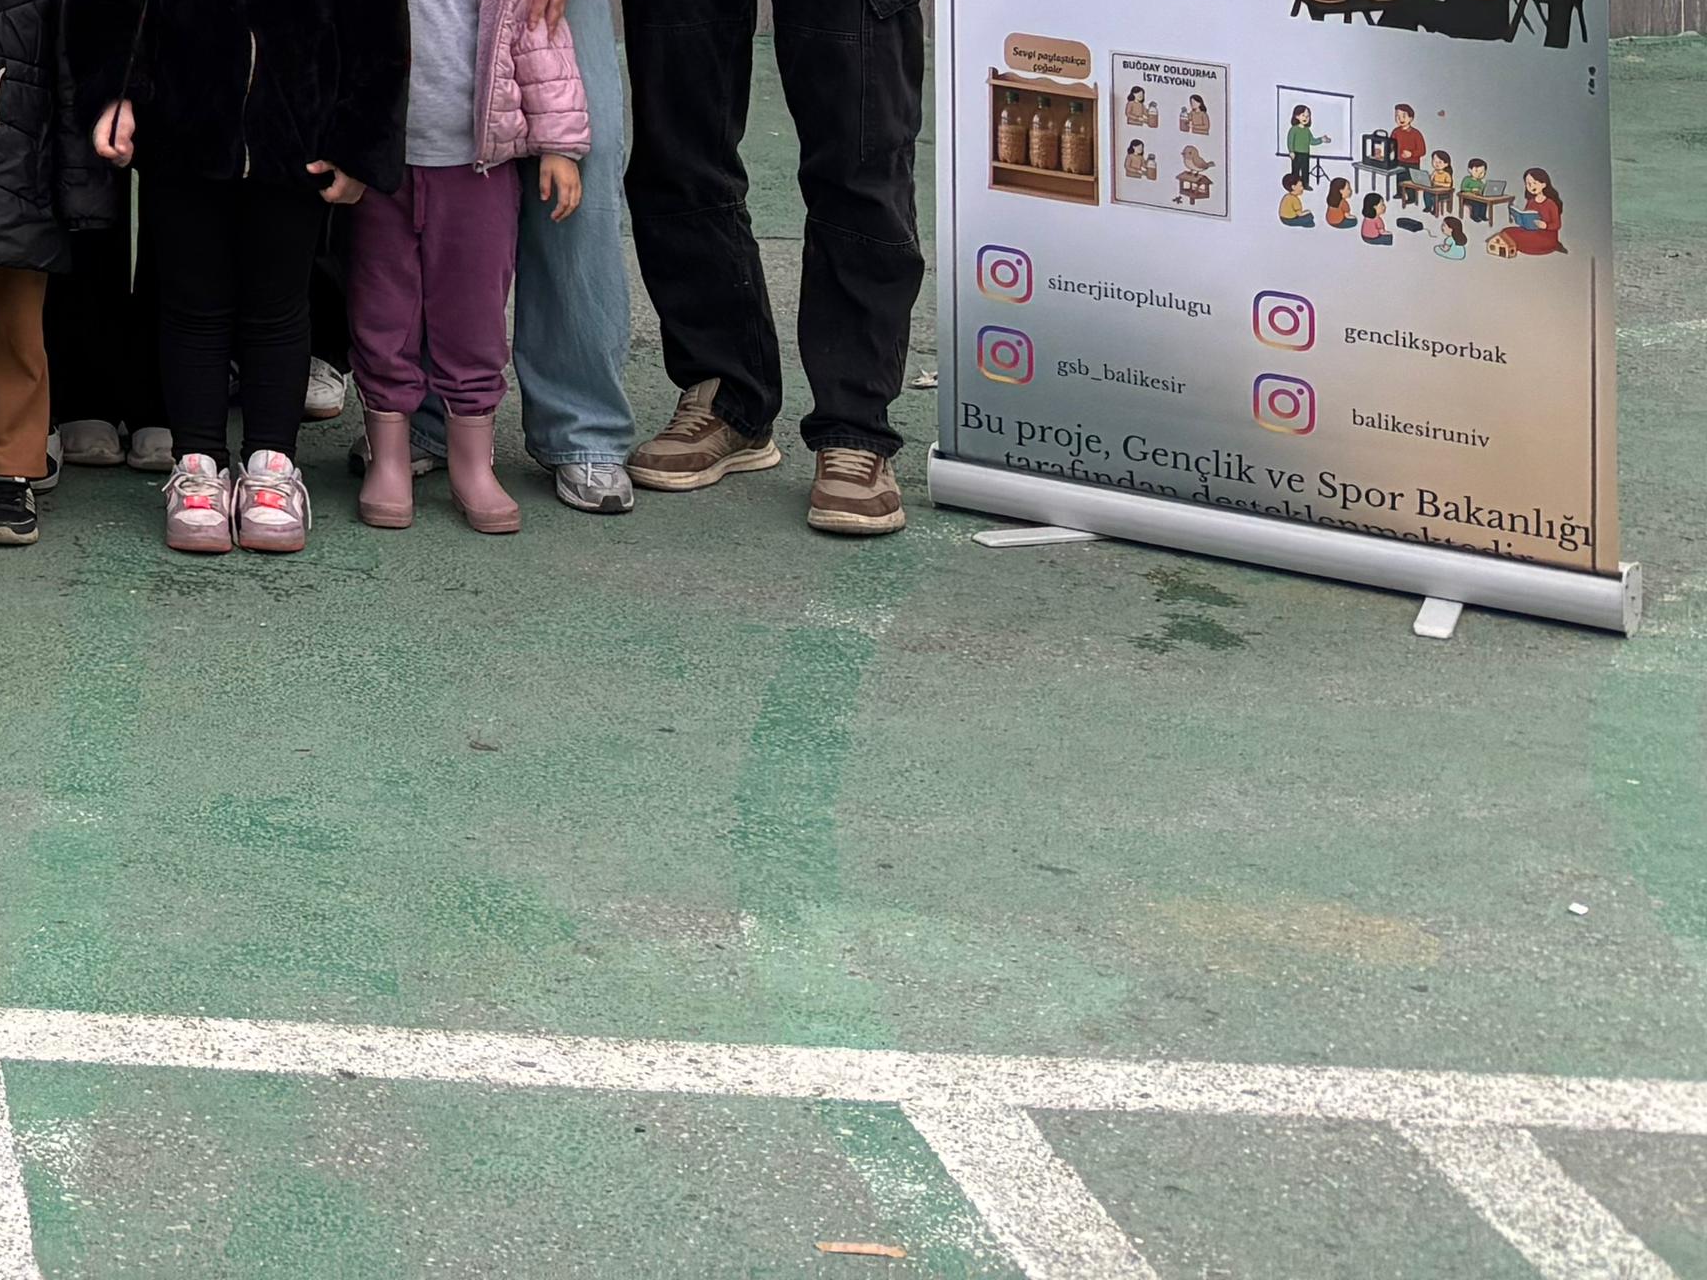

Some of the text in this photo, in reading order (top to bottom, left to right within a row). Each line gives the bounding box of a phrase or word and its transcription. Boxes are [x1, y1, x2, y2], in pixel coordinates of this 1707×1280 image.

[1164, 65, 1217, 80] DOLDURMA
[1048, 274, 1212, 317] sinerjiitoplulugu
[1345, 327, 1507, 364] gencliksporbak
[1057, 358, 1187, 394] gsb_balikesir
[1352, 408, 1490, 448] balikesiruniv
[960, 402, 1005, 436] Bu
[1016, 416, 1110, 460] proje,
[1122, 435, 1256, 484] Gençlik
[1265, 467, 1305, 493] ve
[1317, 471, 1405, 512] Spor
[1416, 488, 1593, 552] Bakanlığı
